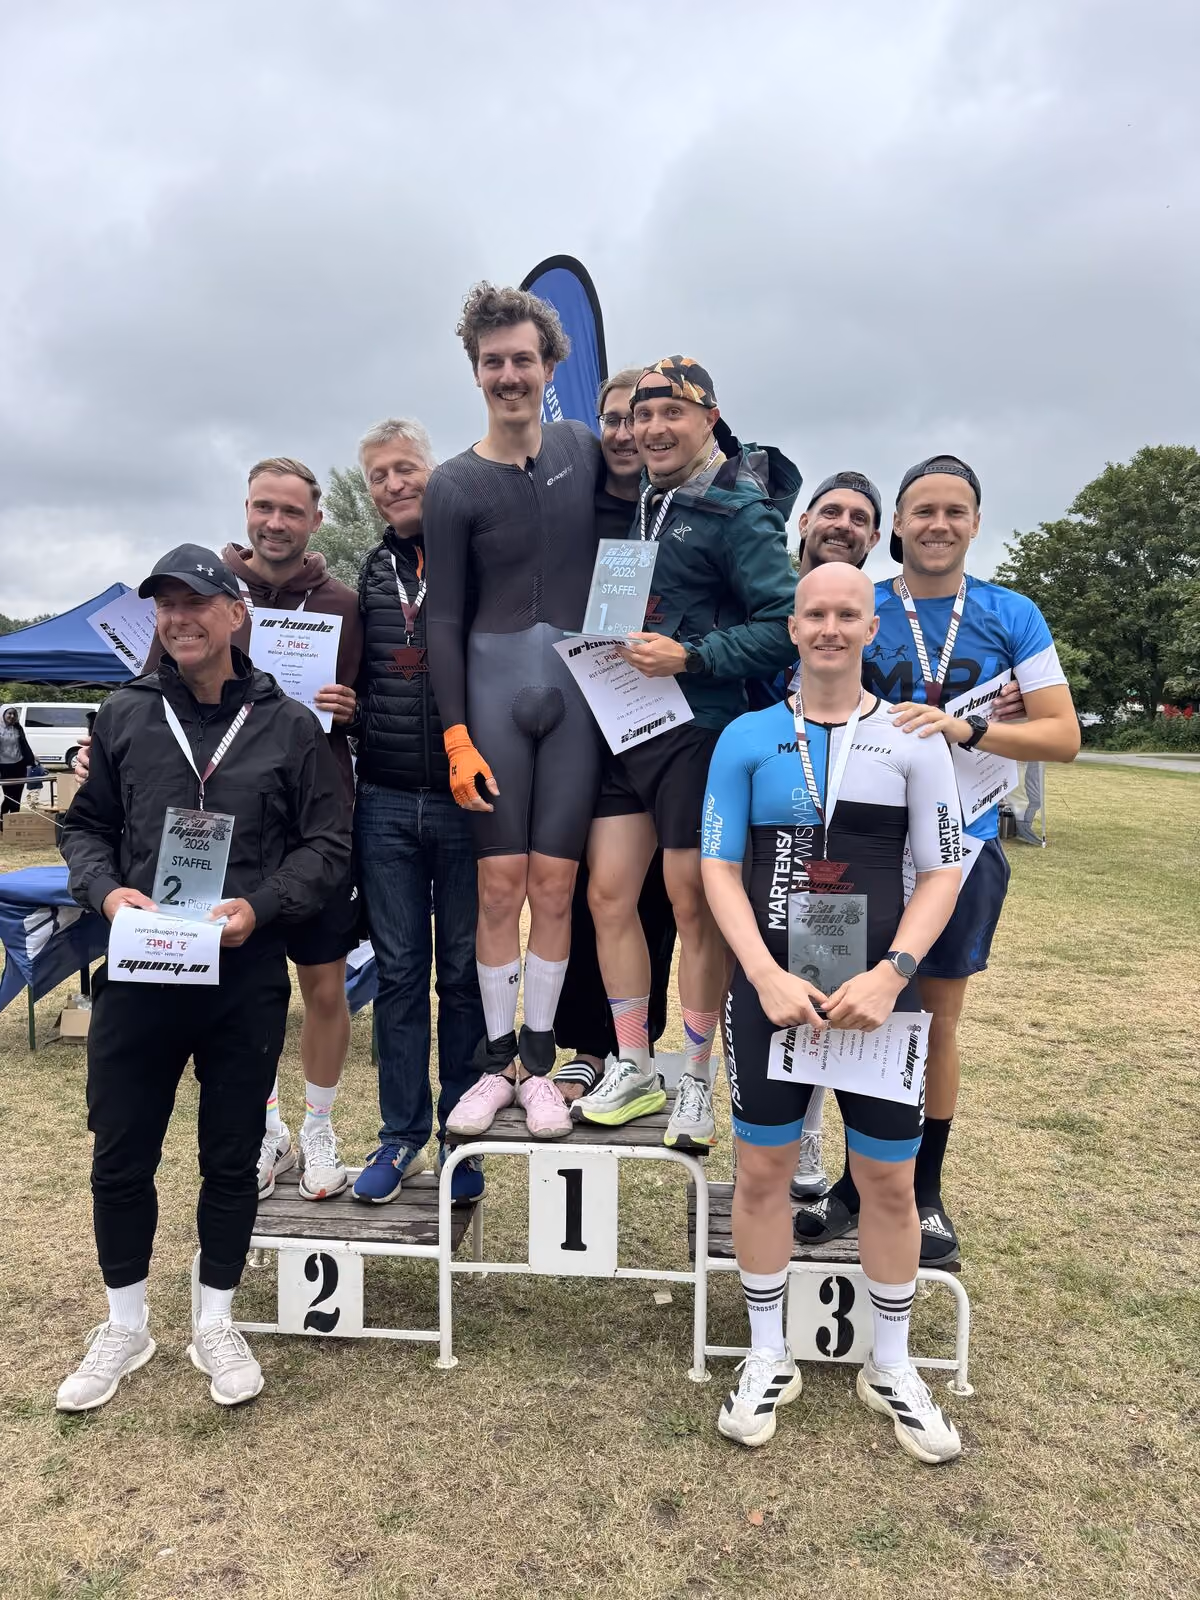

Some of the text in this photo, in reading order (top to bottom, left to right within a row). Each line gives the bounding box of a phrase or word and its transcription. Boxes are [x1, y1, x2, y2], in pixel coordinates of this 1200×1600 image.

[612, 566, 636, 578] 2026
[601, 583, 637, 595] STAFFEL
[259, 616, 335, 633] urkunde
[276, 640, 310, 650] 2. Platz
[594, 658, 604, 667] 1.
[604, 651, 622, 663] Plat
[953, 683, 1003, 718] urkund
[850, 743, 892, 755] ENEROSA
[183, 838, 210, 851] 2026
[172, 856, 213, 870] STAFFEL
[160, 875, 212, 911] 2. Platz
[814, 924, 845, 937] 2026
[146, 938, 187, 950] 2. Platz
[117, 959, 210, 976] urkunde
[809, 1027, 821, 1057] 3. Plat
[557, 1168, 587, 1251] 1
[303, 1252, 340, 1333] 2
[816, 1275, 855, 1358] 3
[879, 1312, 909, 1322] FINGERSC
